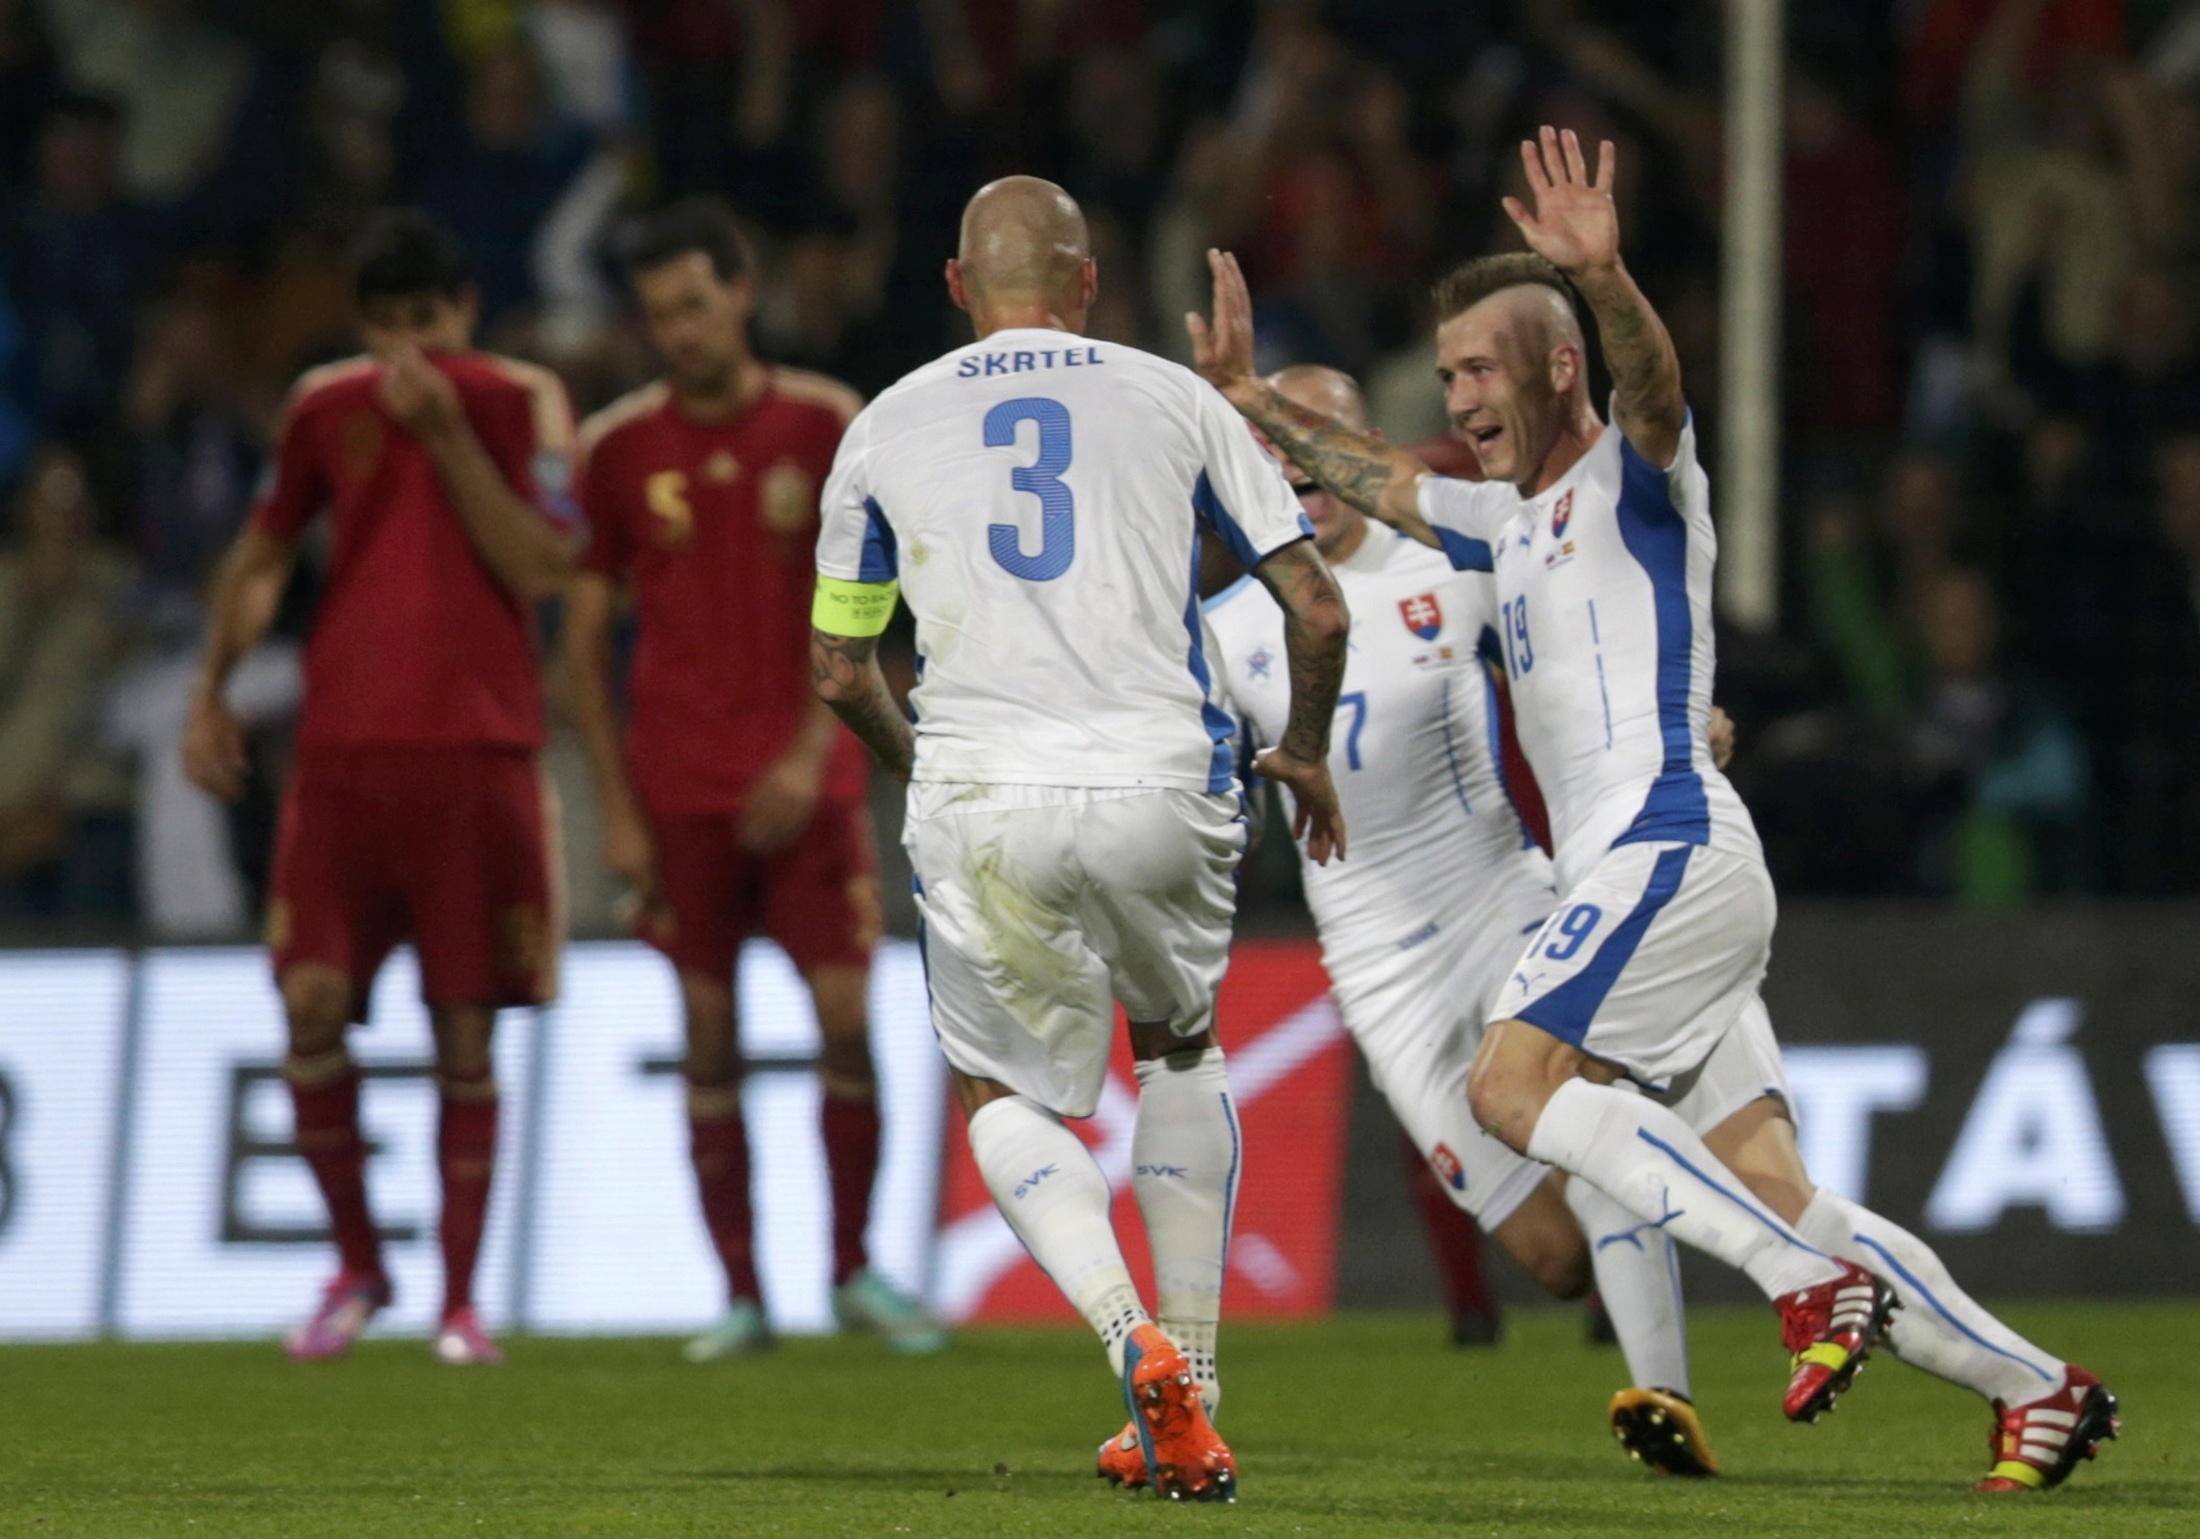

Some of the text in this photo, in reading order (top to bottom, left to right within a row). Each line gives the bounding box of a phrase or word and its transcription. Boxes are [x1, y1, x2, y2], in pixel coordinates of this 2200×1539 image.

[956, 346, 1105, 378] SKRTEL
[645, 470, 693, 547] 5
[983, 396, 1076, 582] 3
[1502, 592, 1534, 681] 19
[1336, 690, 1368, 772] 7
[1525, 902, 1603, 961] 19
[1783, 997, 2200, 1233] TÁ
[1013, 1163, 1060, 1201] SVK
[1135, 1164, 1188, 1180] SVK
